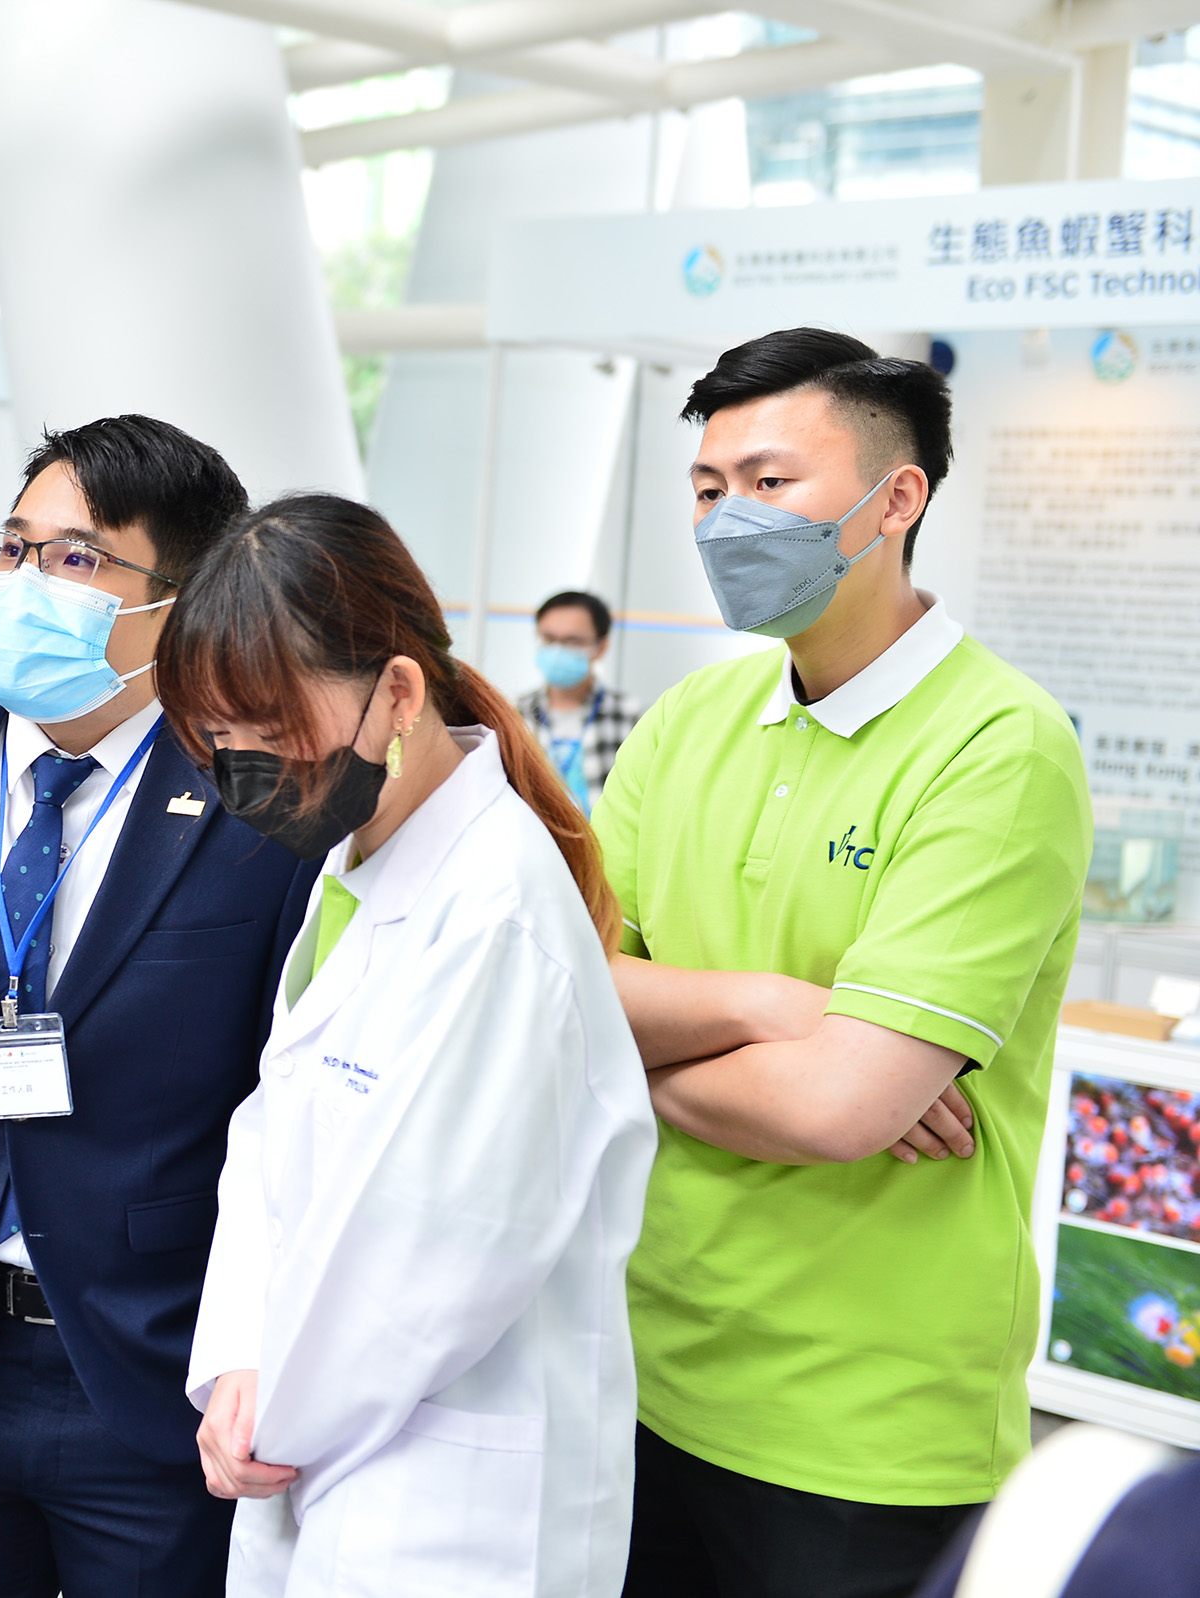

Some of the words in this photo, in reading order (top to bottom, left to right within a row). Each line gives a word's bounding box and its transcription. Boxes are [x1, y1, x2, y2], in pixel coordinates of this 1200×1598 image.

[927, 209, 1194, 265] 生態魚蝦蟹科
[967, 275, 1016, 301] Eco
[1025, 271, 1080, 298] FSC
[1090, 264, 1200, 297] Techno
[828, 825, 876, 870] VTC
